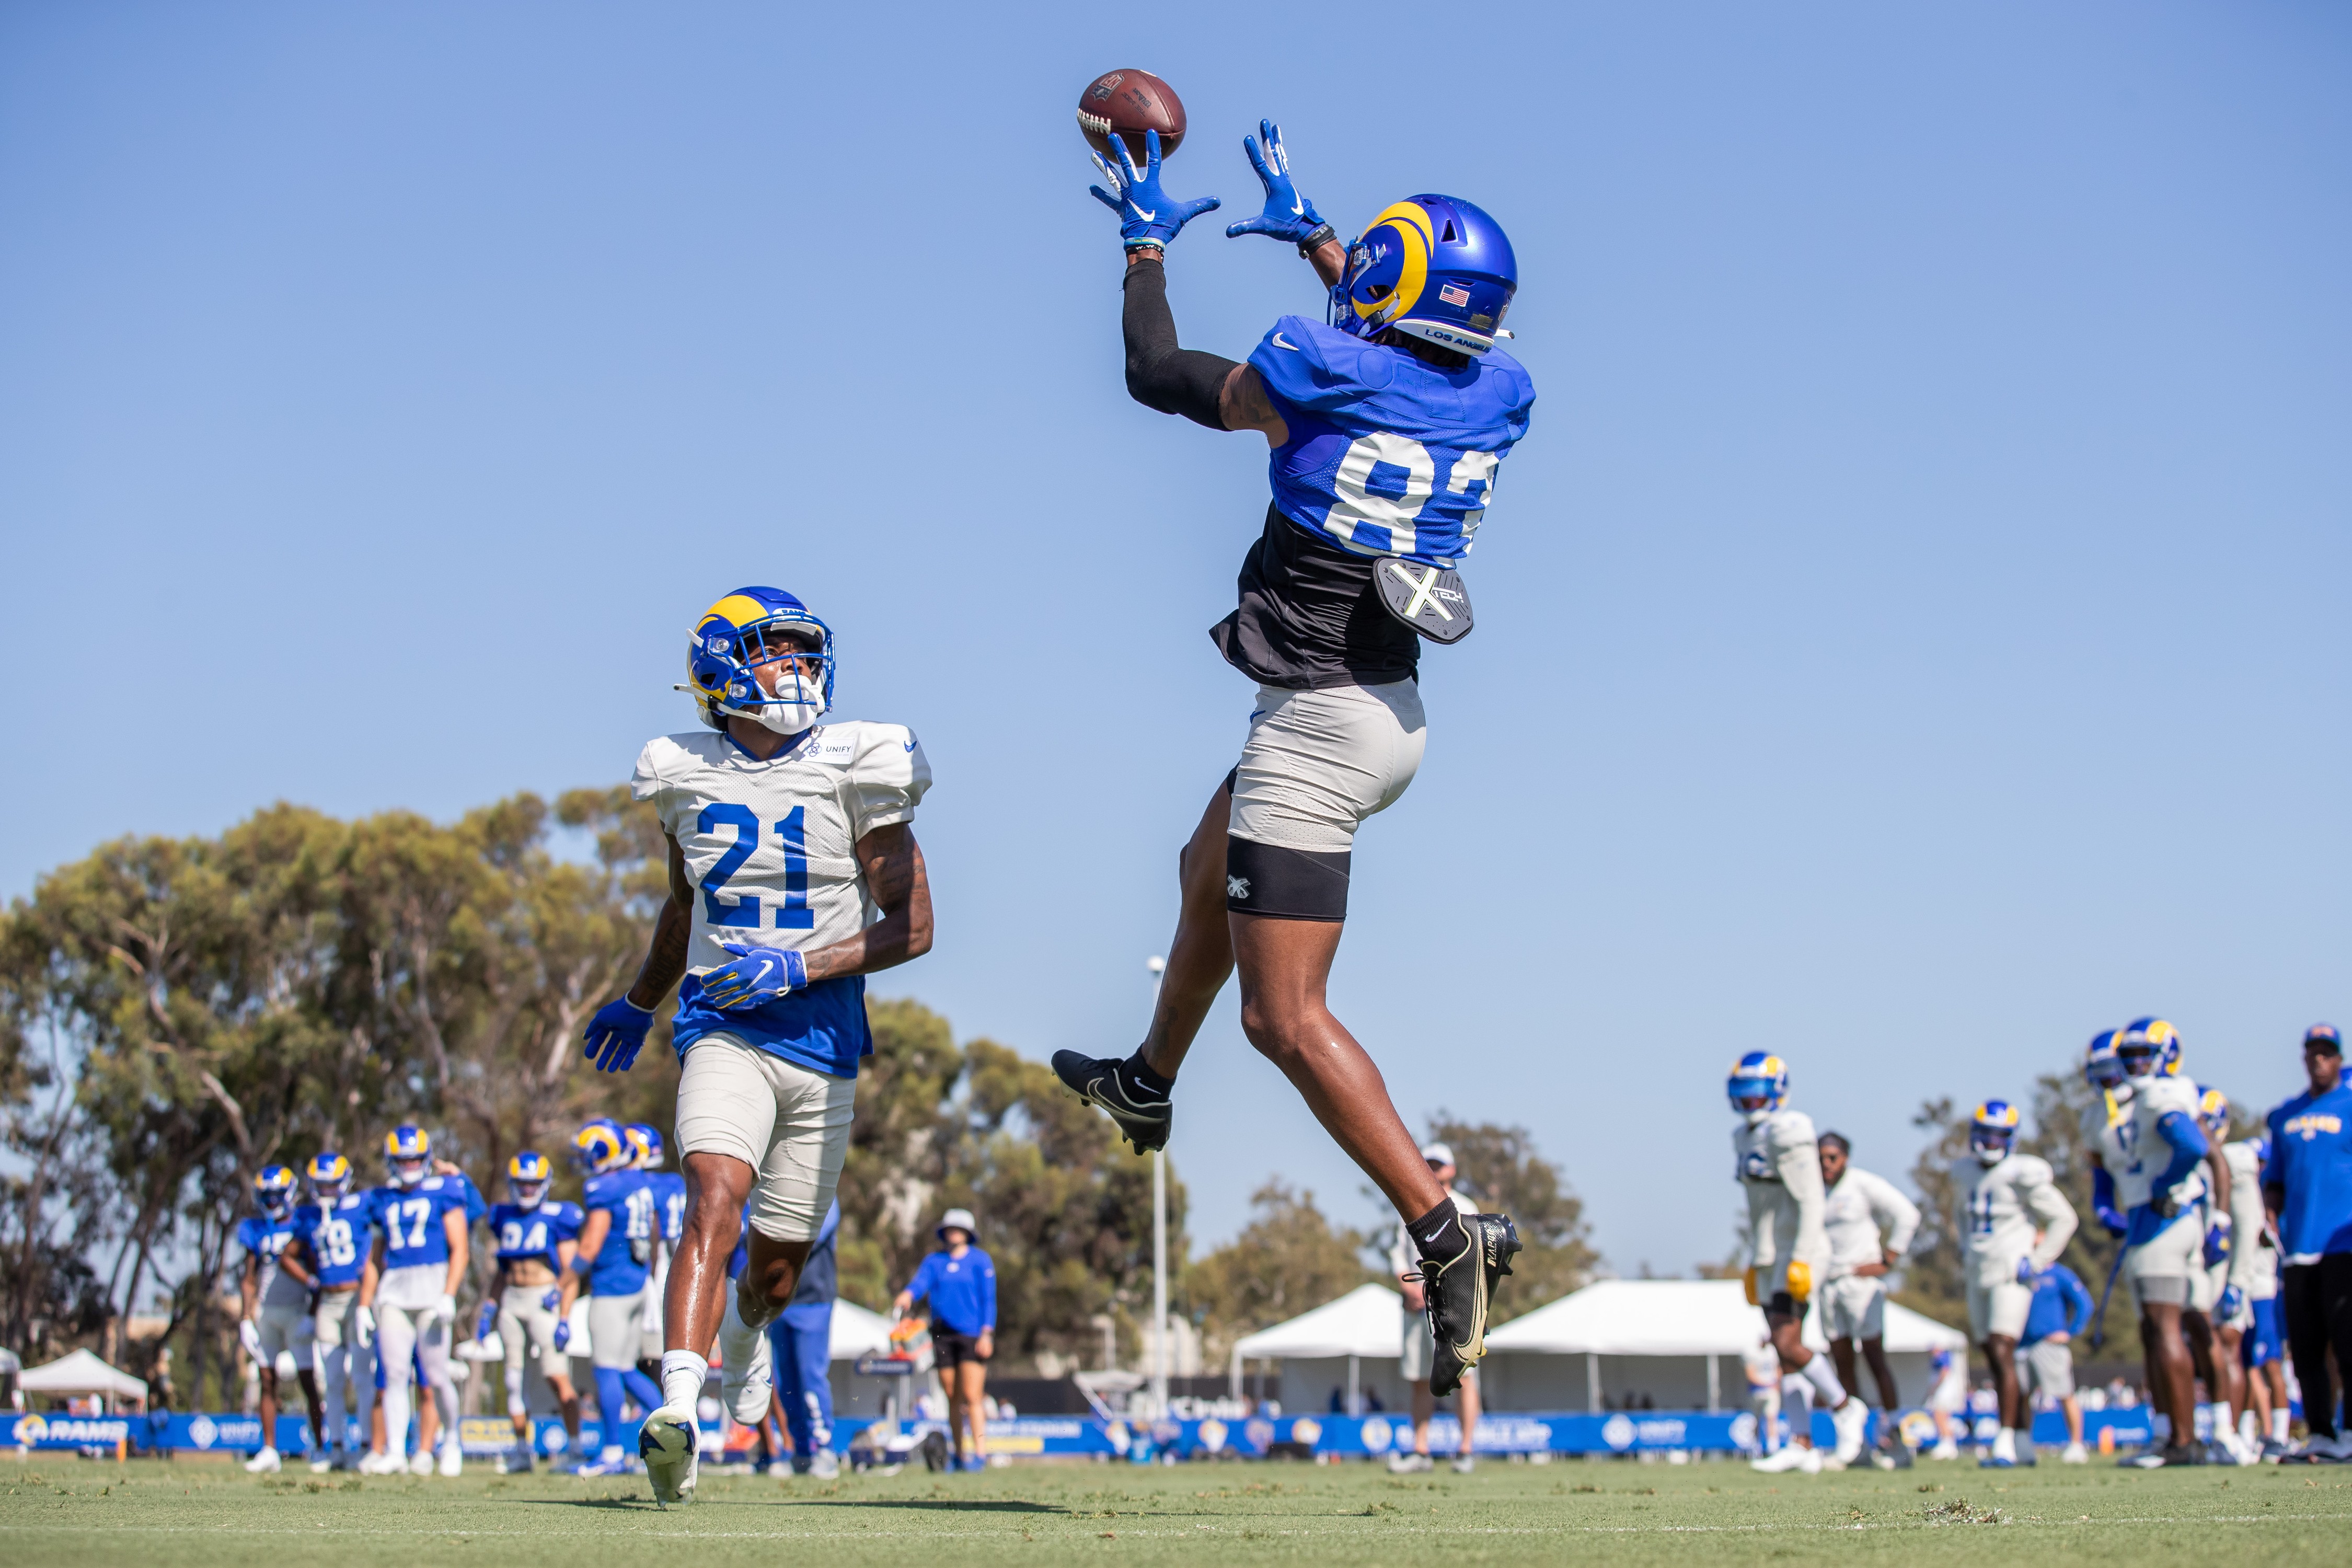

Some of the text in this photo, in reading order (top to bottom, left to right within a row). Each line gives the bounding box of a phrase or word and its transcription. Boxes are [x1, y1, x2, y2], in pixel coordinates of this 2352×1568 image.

[1425, 328, 1454, 341] LOS
[697, 803, 814, 929] 21
[385, 1197, 431, 1250] 17
